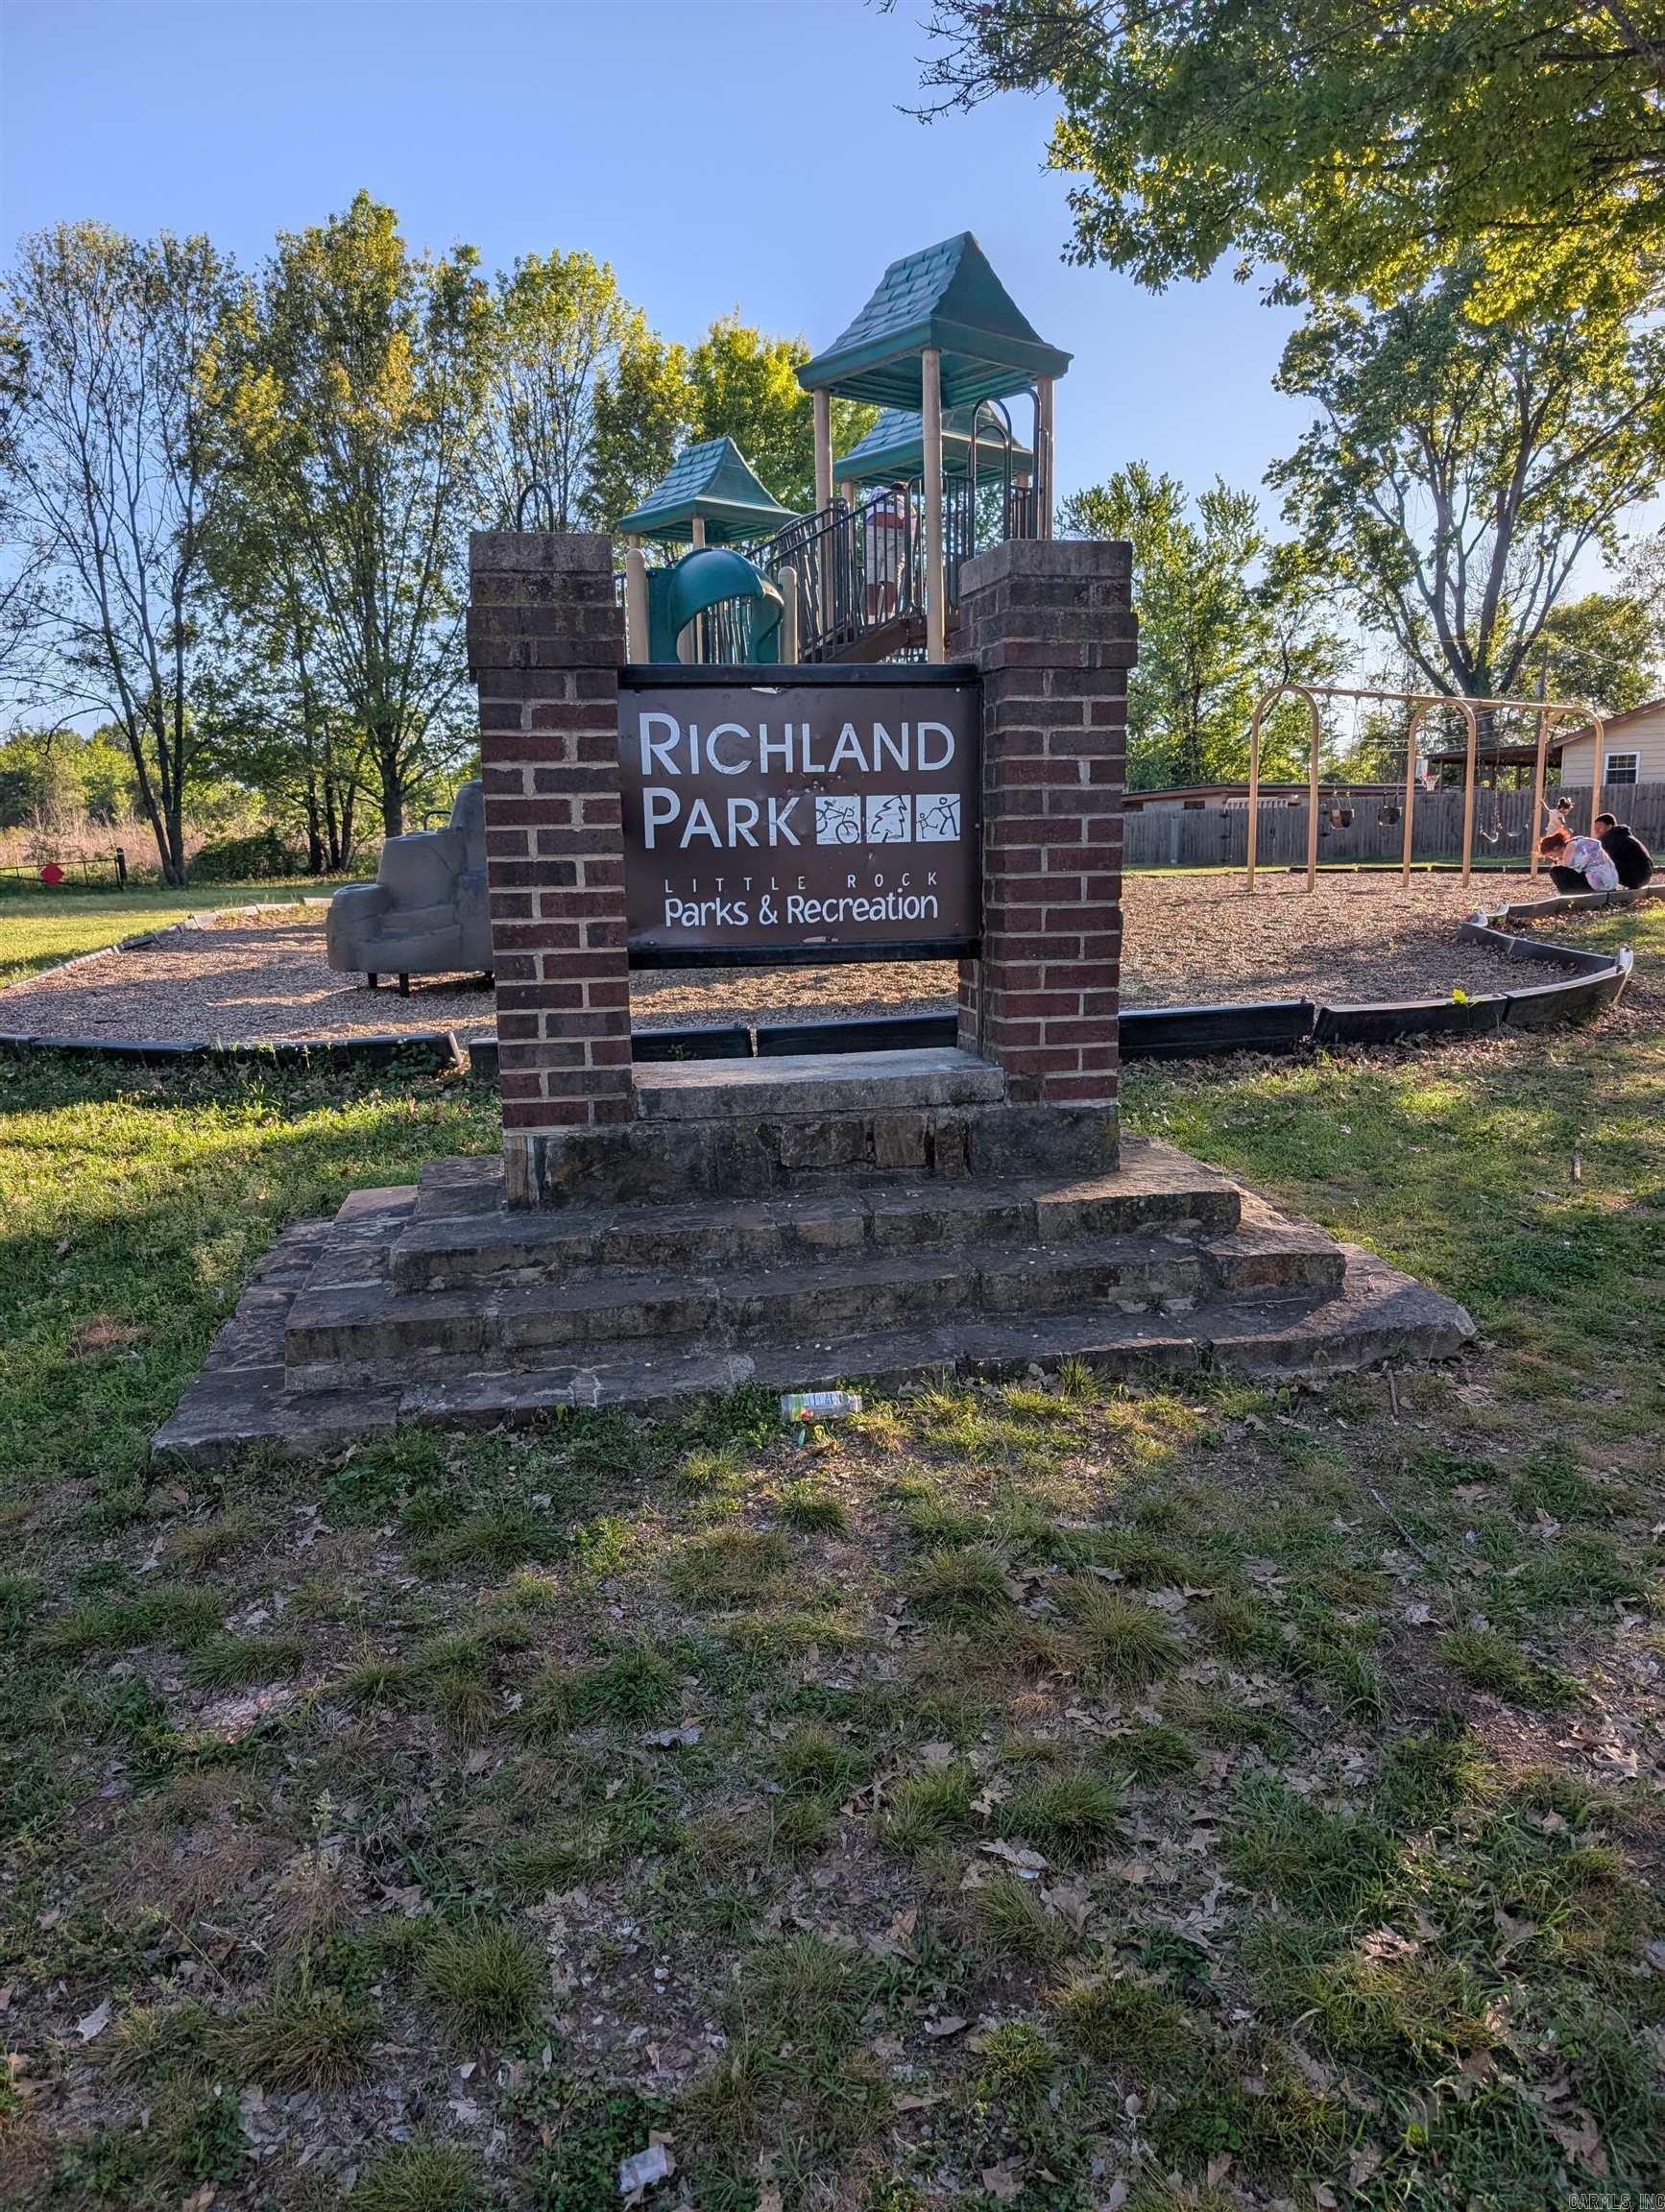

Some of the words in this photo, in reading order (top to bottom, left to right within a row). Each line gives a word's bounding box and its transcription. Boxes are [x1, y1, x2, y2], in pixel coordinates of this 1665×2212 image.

[639, 712, 955, 776] RICHLAND
[642, 787, 801, 849] PARK
[664, 876, 806, 893] LITTLE
[847, 872, 937, 889] ROCK
[664, 897, 749, 927] Parks
[759, 894, 779, 926] &
[786, 887, 938, 924] Recreation
